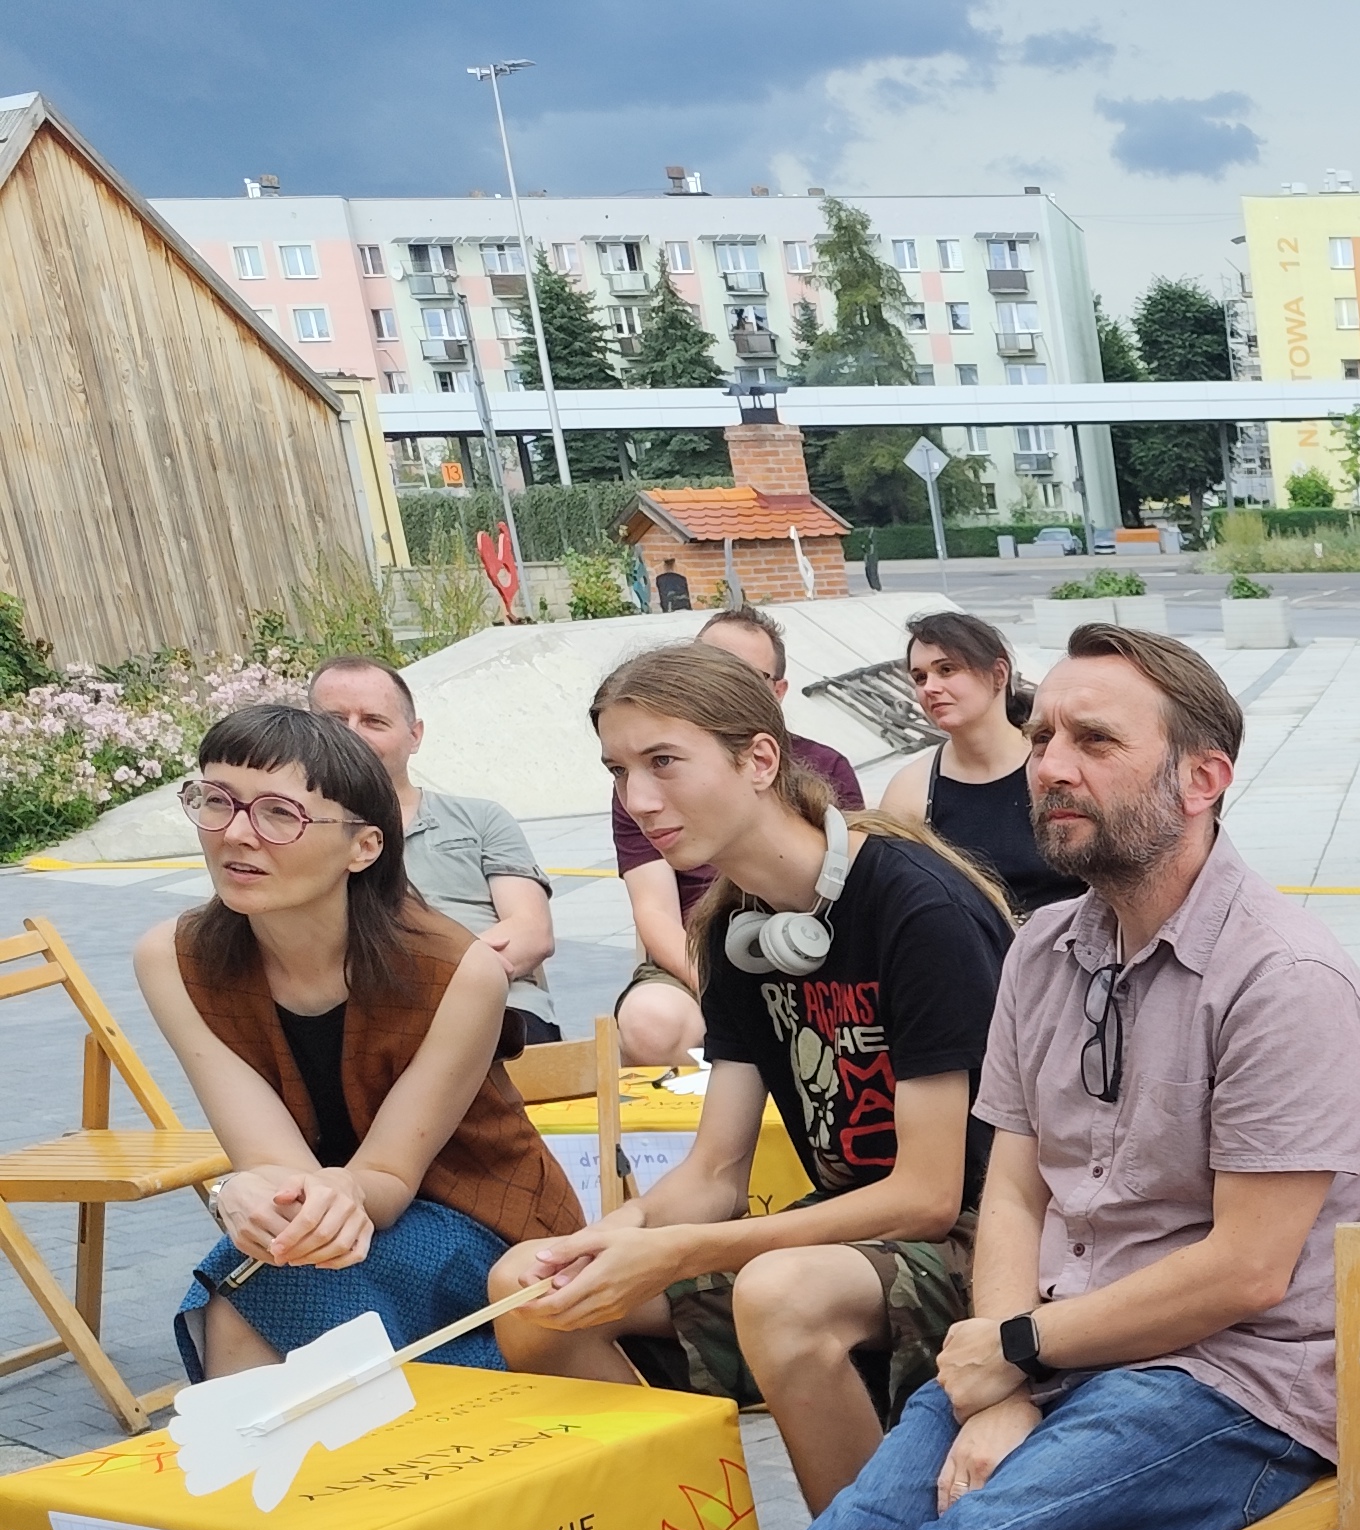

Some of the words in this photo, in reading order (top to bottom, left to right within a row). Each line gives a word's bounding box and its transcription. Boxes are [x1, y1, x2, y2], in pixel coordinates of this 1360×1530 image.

[1283, 296, 1312, 381] TOWA
[445, 466, 461, 481] 13
[580, 1152, 668, 1168] dryna
